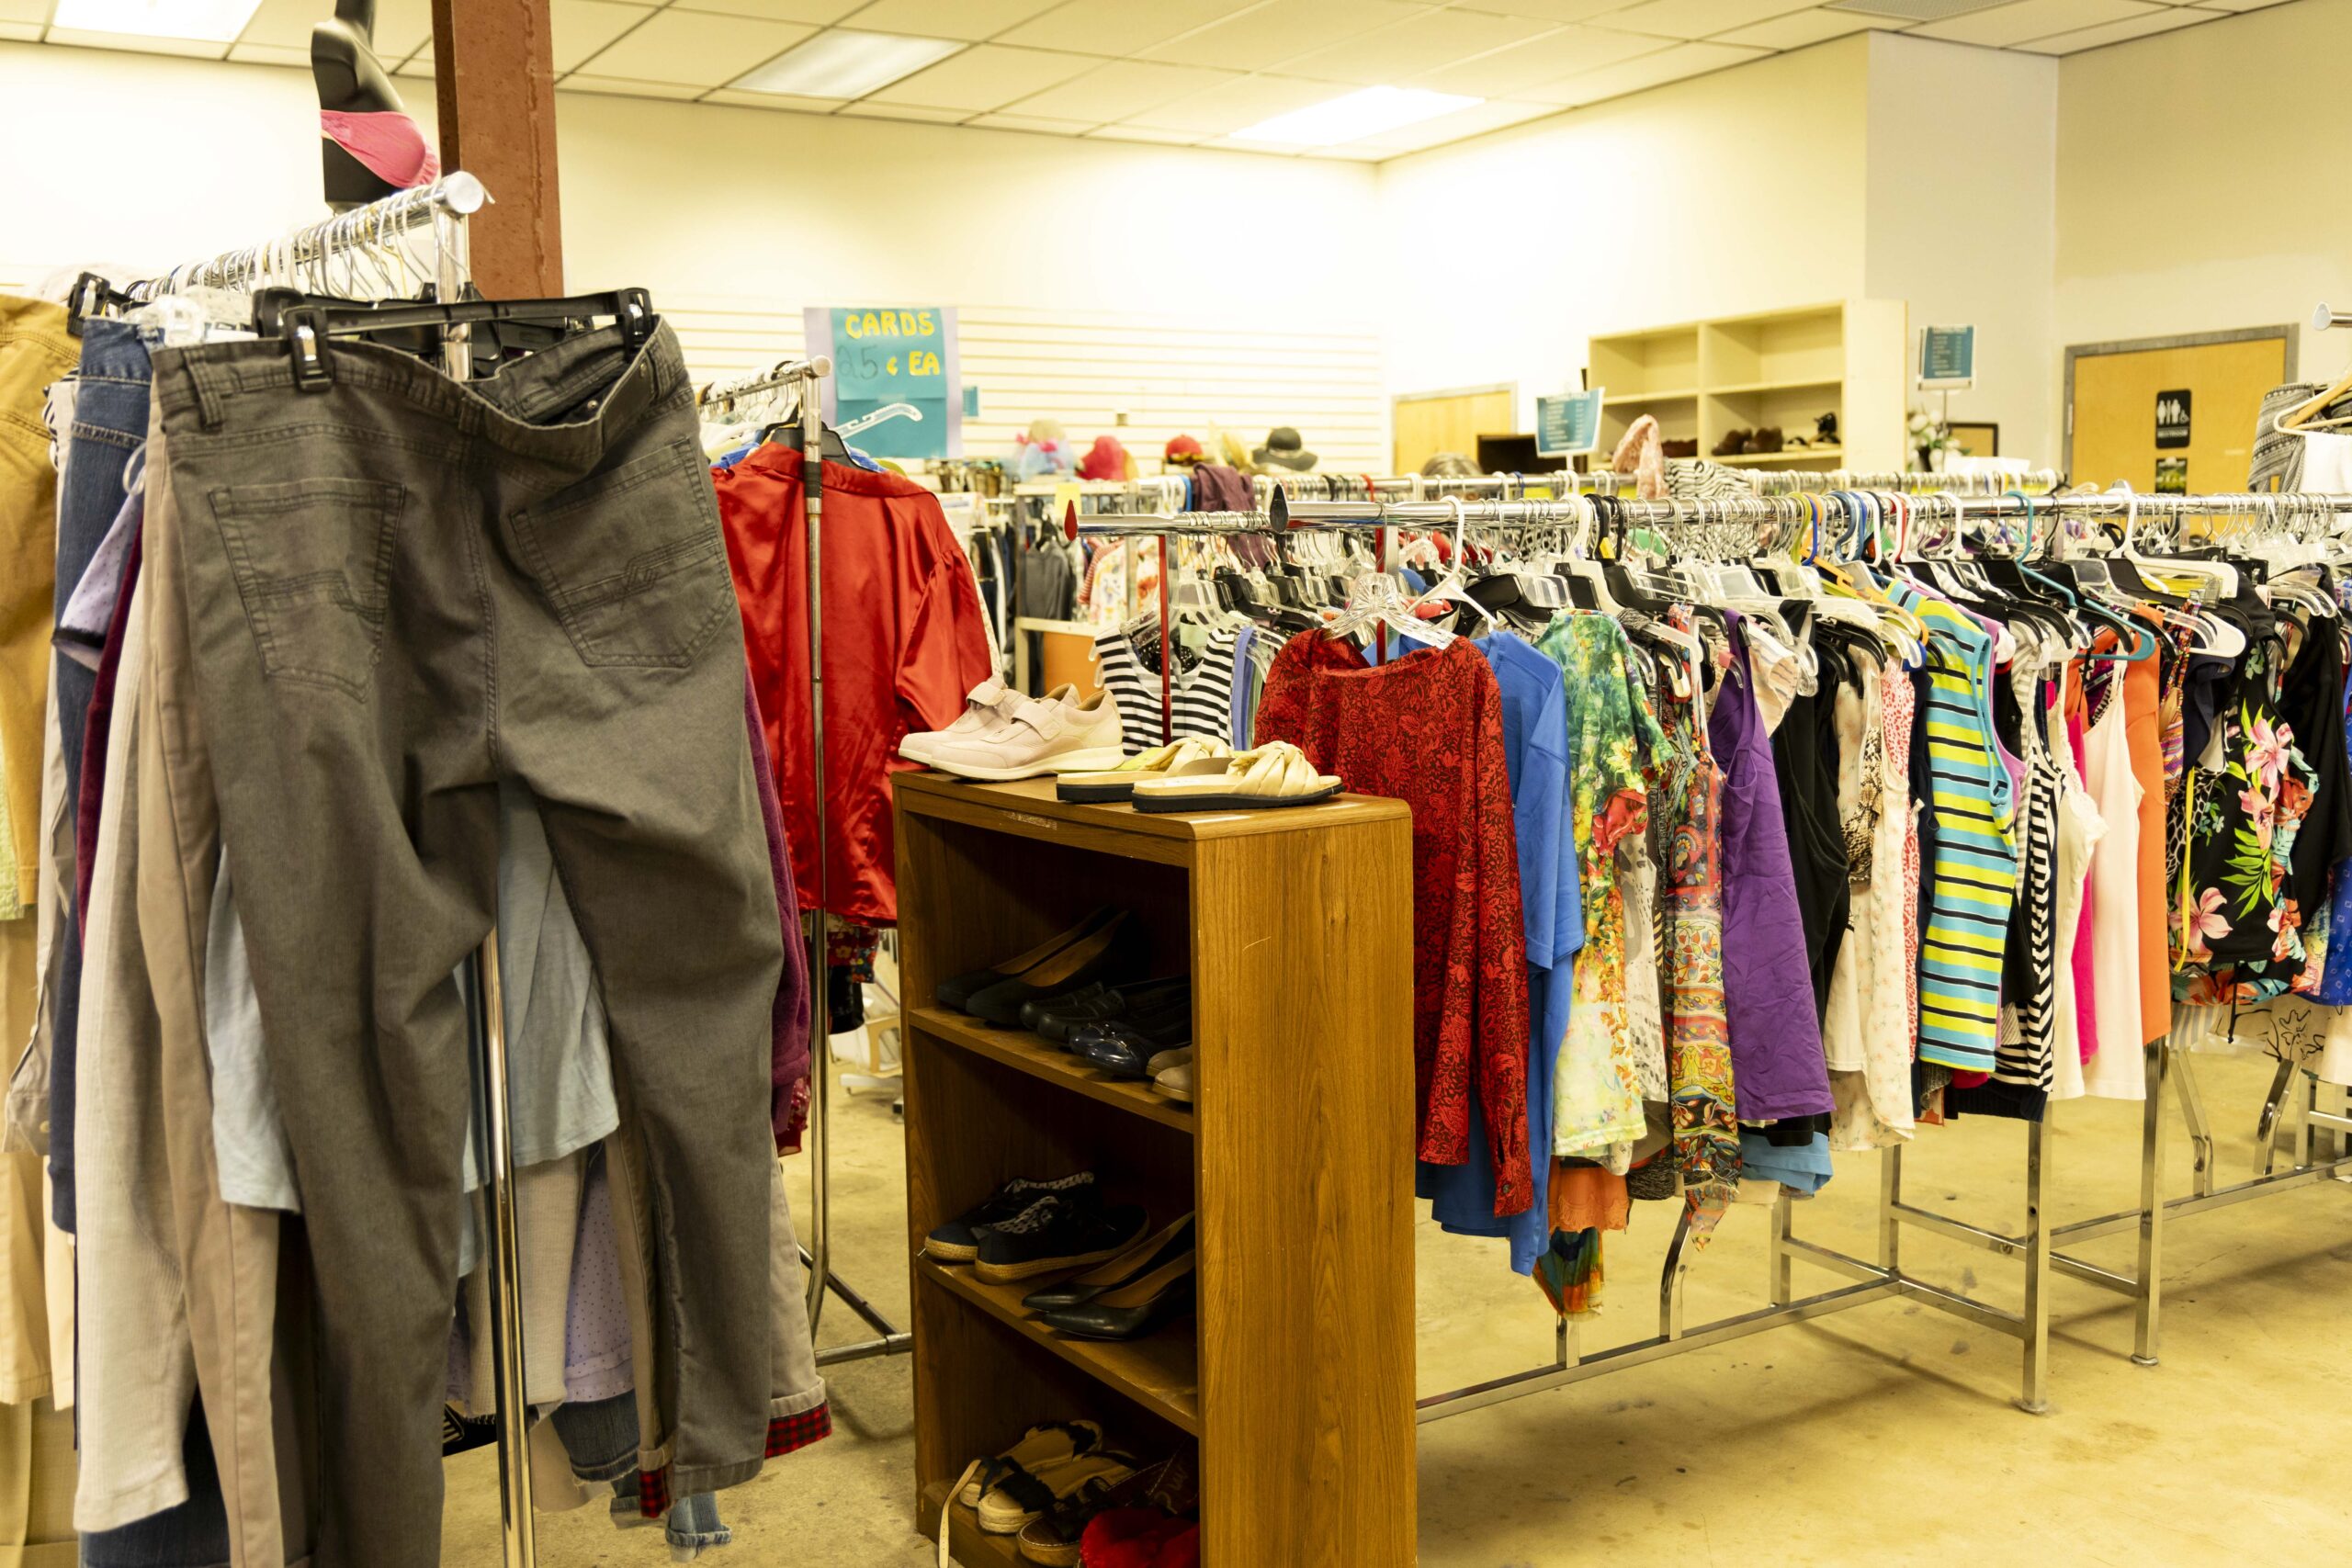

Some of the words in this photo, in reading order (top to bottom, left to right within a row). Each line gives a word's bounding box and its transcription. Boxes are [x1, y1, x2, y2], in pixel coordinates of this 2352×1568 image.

[845, 310, 935, 339] CARDS
[836, 344, 879, 380] 25
[909, 350, 941, 376] EA
